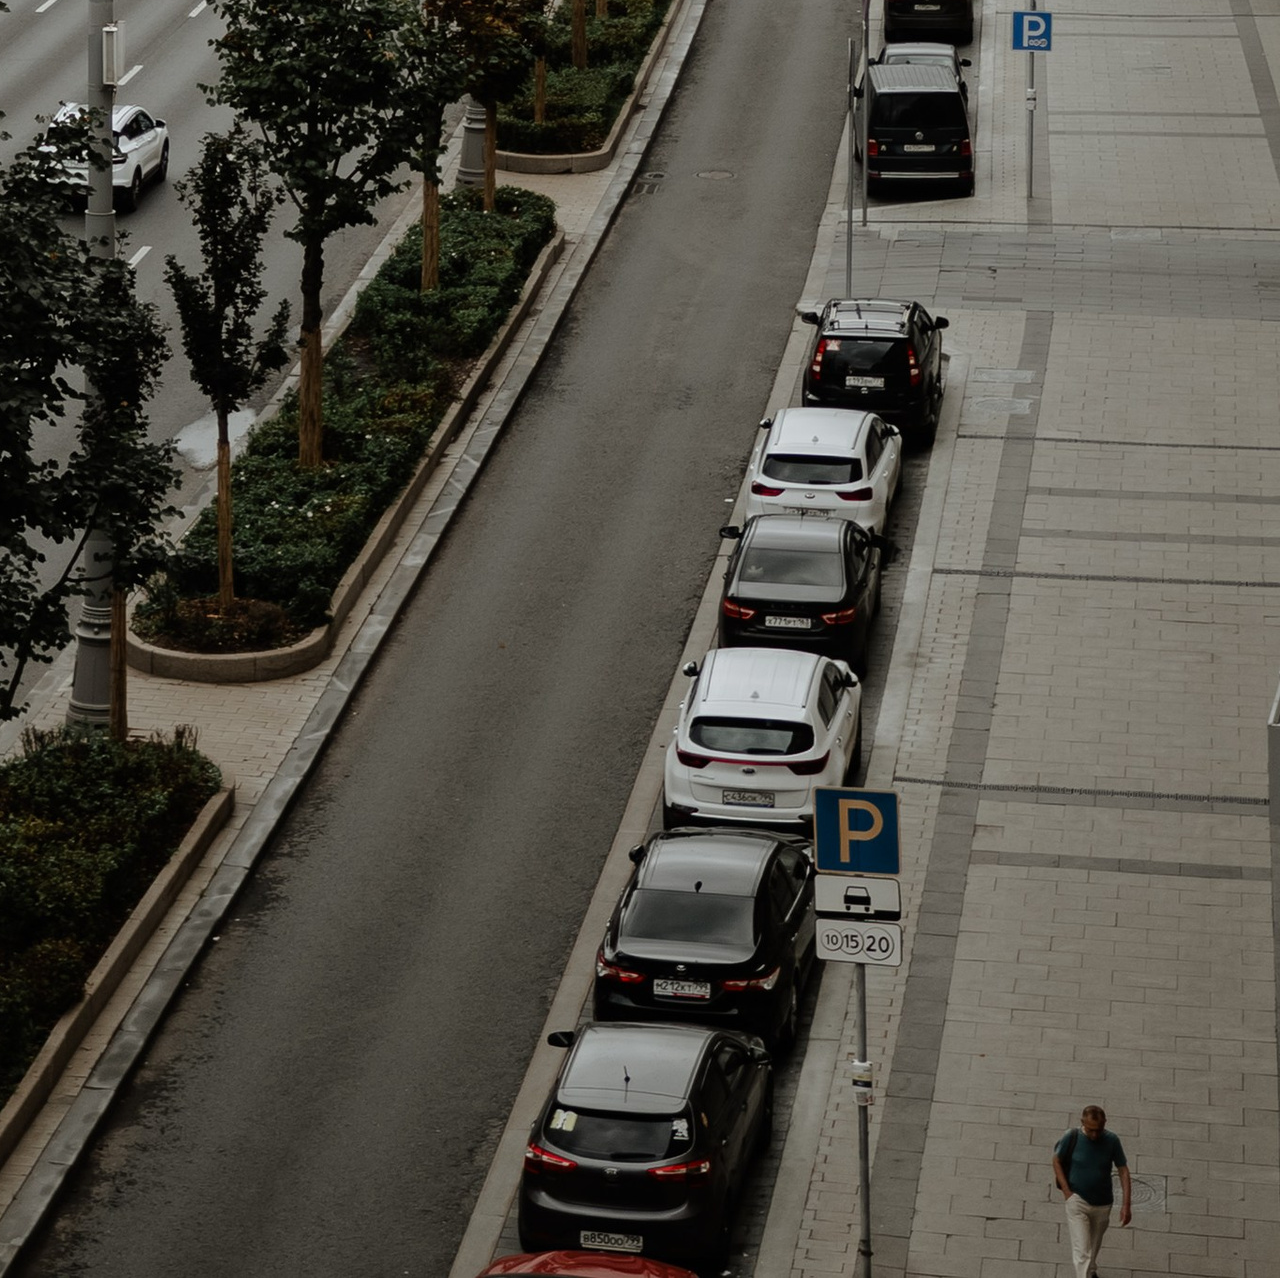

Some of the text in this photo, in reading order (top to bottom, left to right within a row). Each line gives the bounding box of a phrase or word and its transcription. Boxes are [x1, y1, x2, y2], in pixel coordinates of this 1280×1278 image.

[1023, 15, 1046, 47] P
[838, 798, 884, 863] P
[825, 933, 890, 954] 10 15 20
